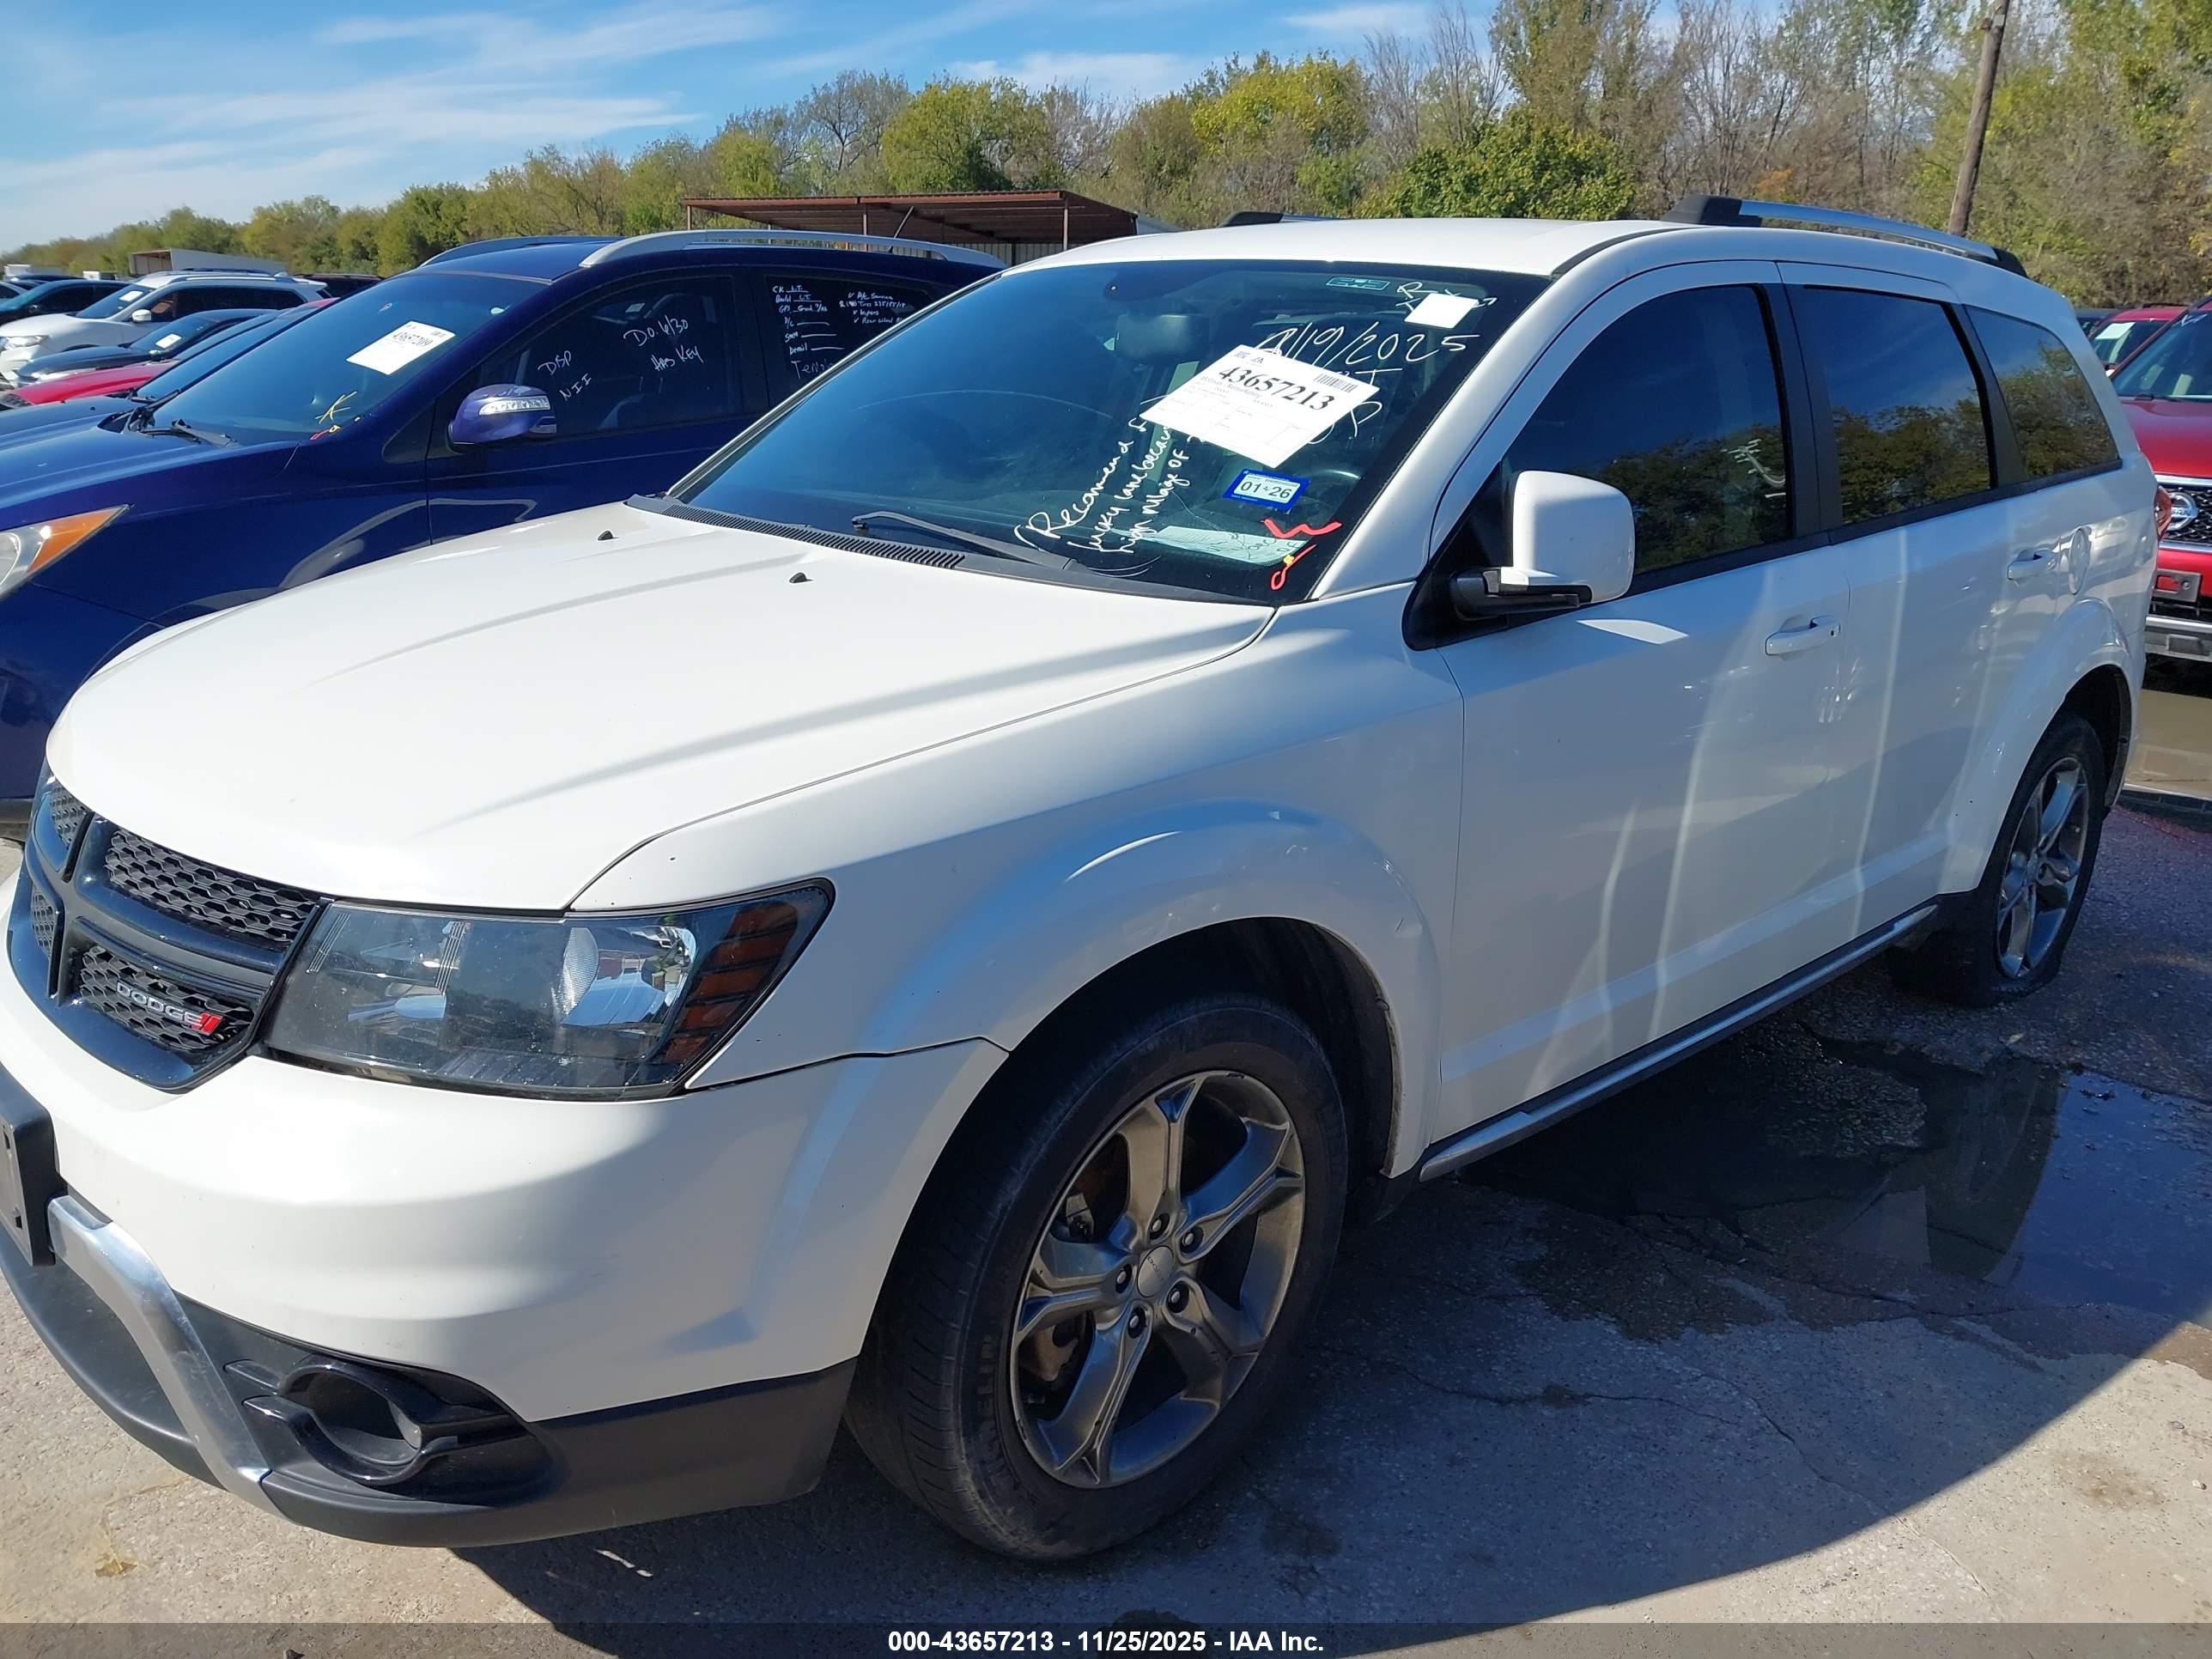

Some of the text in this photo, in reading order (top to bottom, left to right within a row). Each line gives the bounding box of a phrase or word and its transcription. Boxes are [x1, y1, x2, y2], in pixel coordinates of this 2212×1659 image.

[1218, 366, 1335, 410] 43657213
[1240, 481, 1262, 494] 01
[1268, 486, 1293, 499] 26
[116, 981, 204, 1028] DODGE
